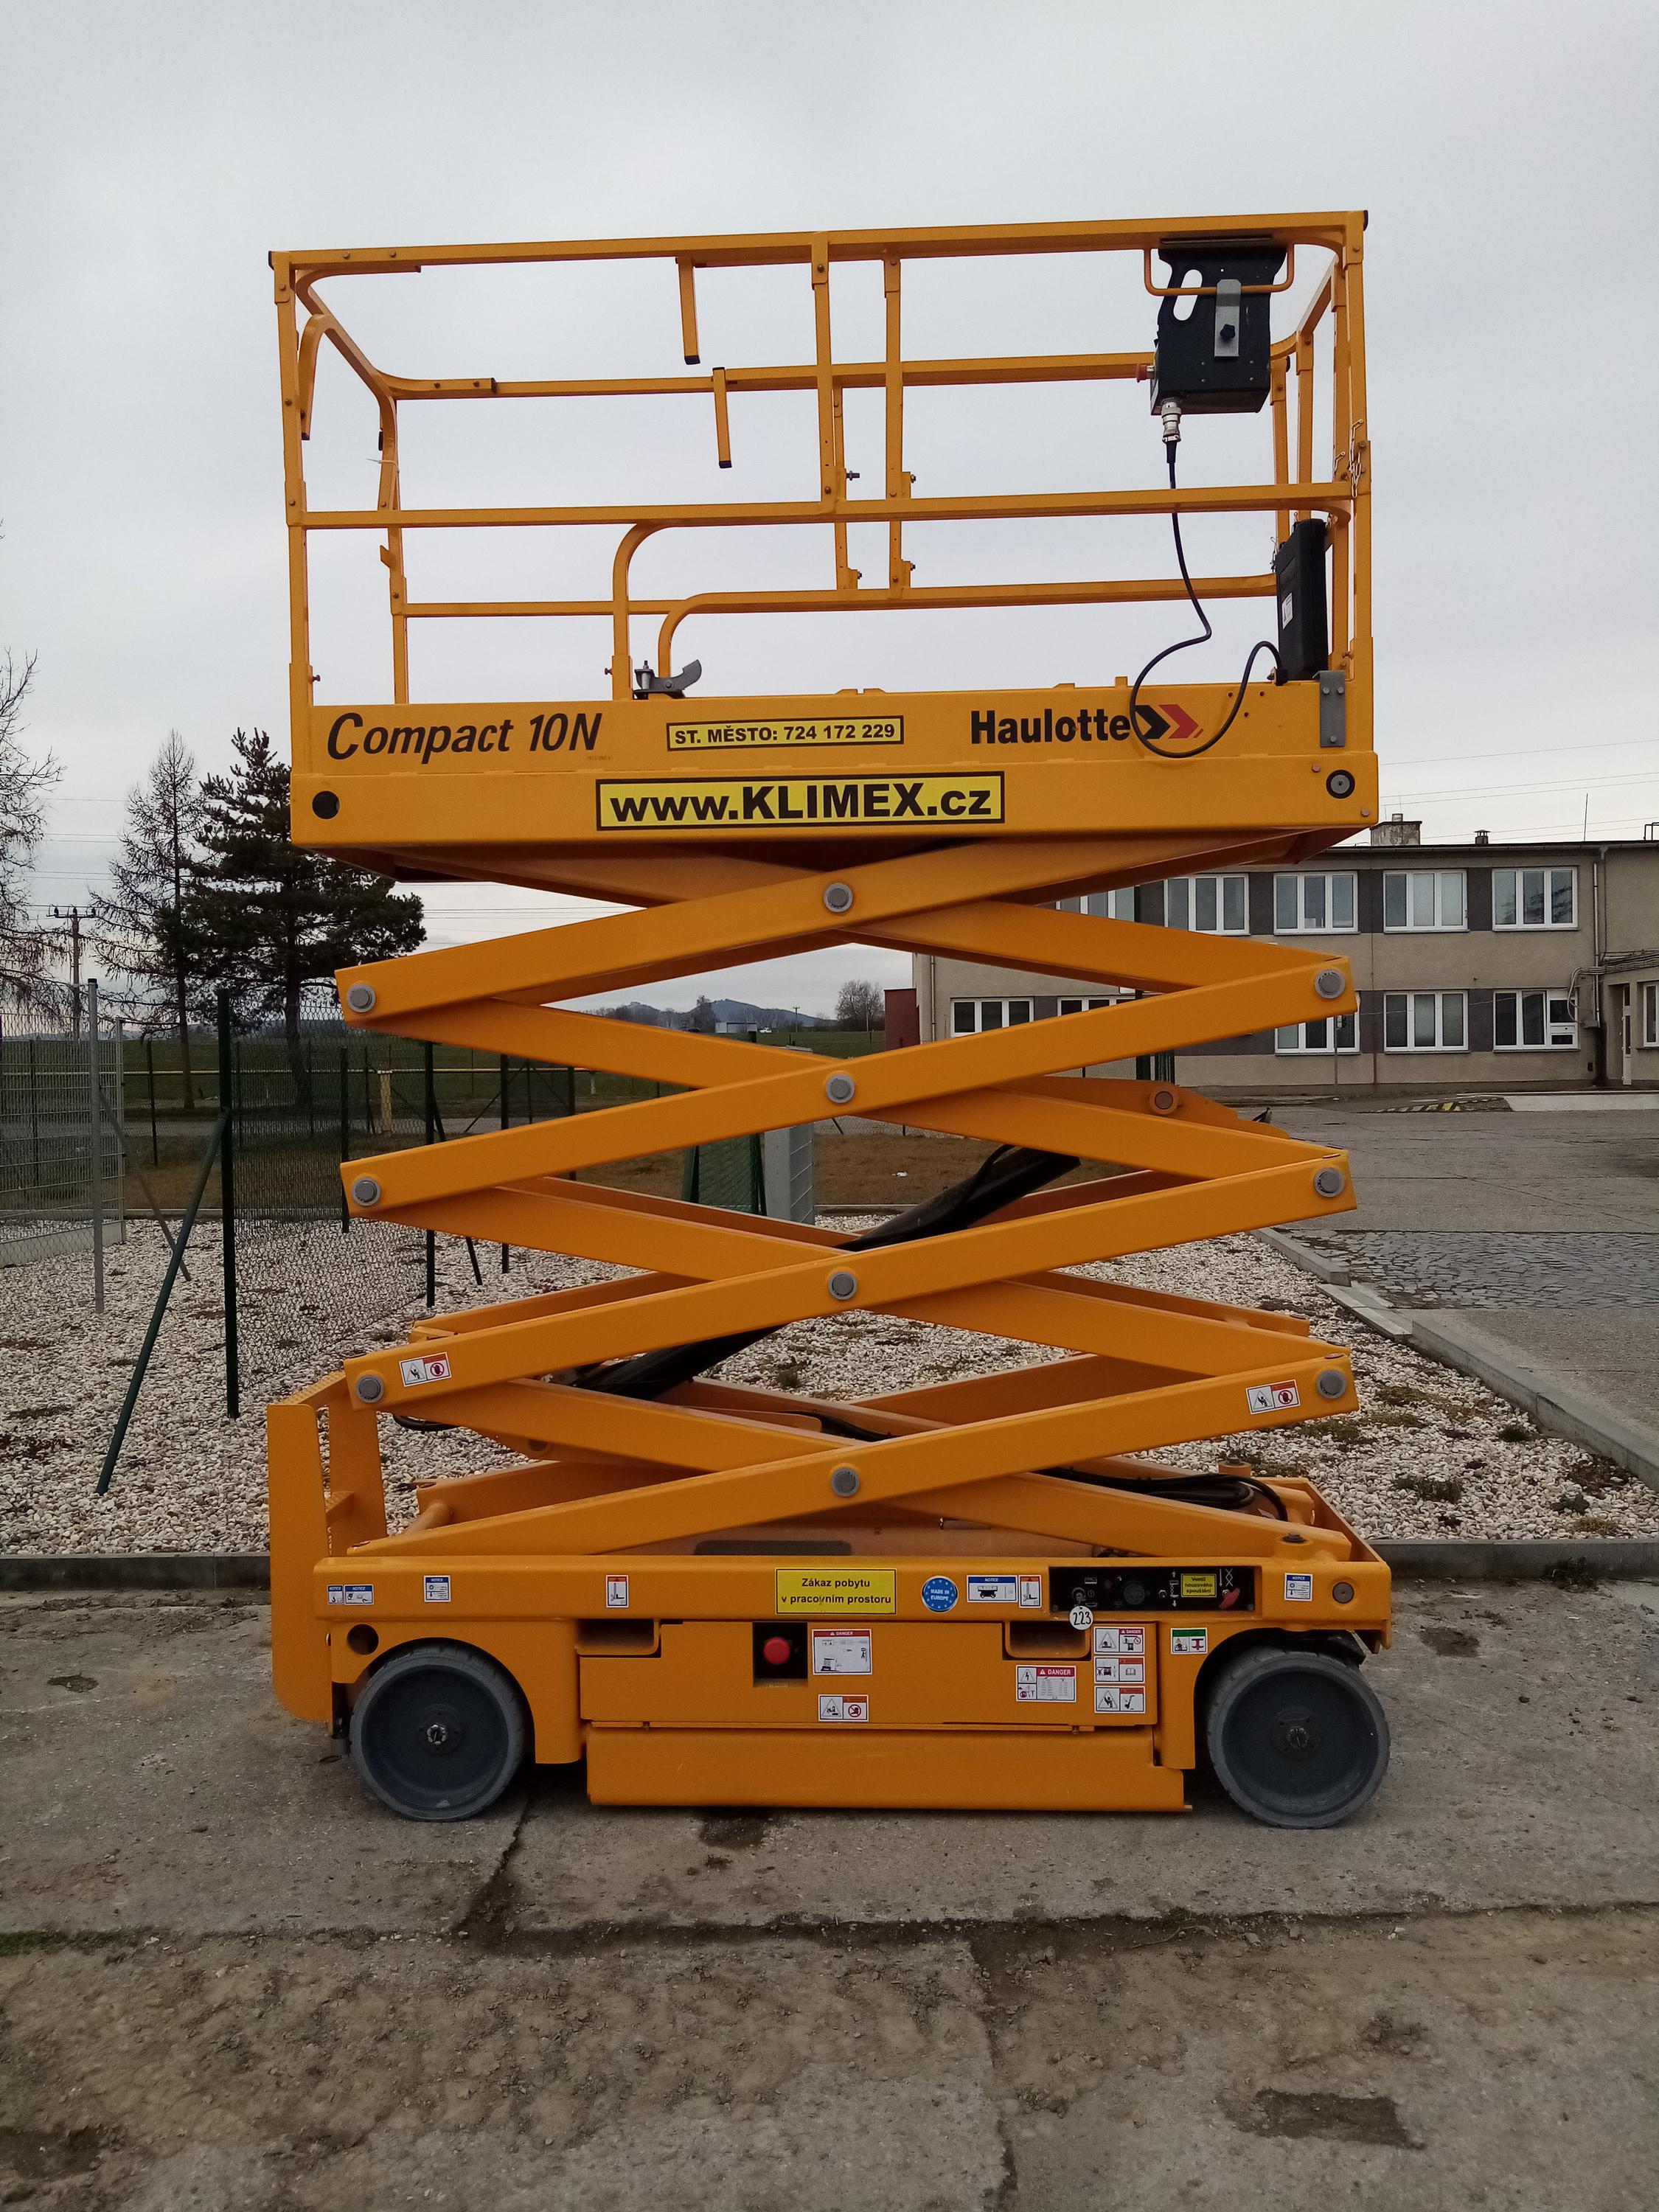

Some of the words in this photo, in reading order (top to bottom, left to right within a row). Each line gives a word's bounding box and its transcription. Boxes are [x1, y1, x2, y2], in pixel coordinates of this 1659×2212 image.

[675, 729, 701, 745] ST.
[709, 724, 778, 742] MĚSTO:
[783, 726, 817, 741] 724
[824, 725, 856, 740] 172
[862, 723, 895, 739] 229
[970, 709, 1130, 745] Haulotte
[327, 712, 514, 765] Compact
[529, 712, 602, 752] 10N
[610, 782, 992, 822] www.KLIMEX.cz
[801, 1578, 832, 1587] Zákaz
[835, 1579, 870, 1589] pobytu
[847, 1595, 891, 1605] prostoru
[1073, 1611, 1091, 1625] 223
